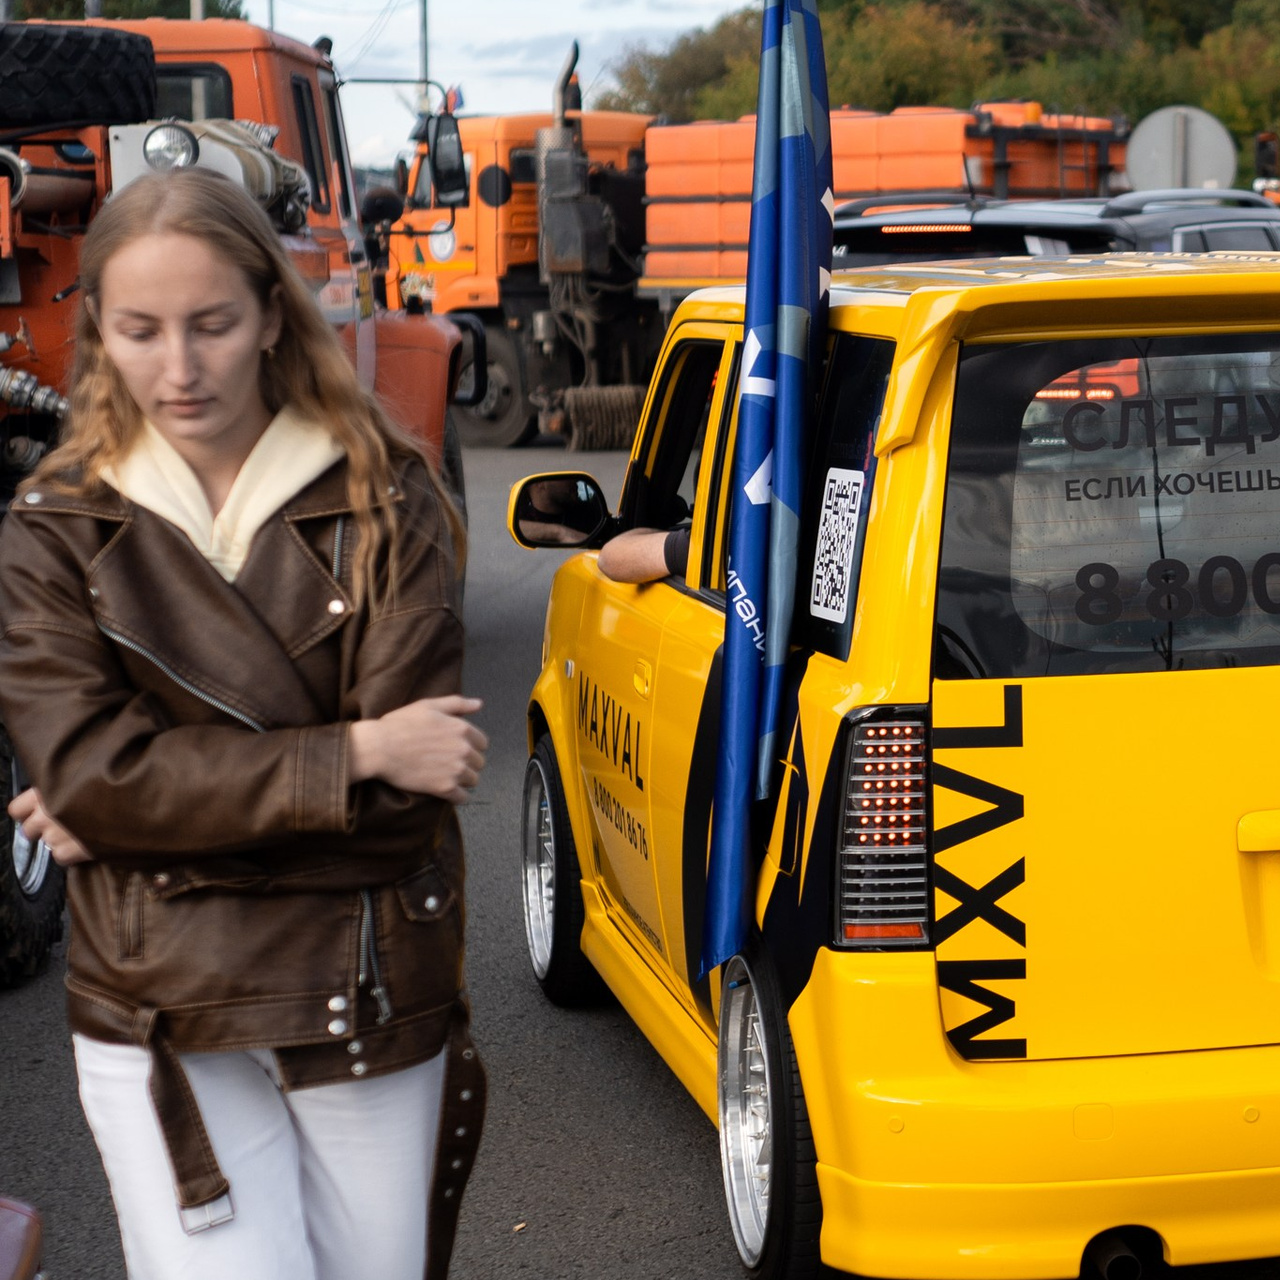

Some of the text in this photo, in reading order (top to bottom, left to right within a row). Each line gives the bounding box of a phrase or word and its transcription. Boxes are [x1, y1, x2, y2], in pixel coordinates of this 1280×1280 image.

[1064, 475, 1147, 502] ЕСЛИ
[1073, 562, 1124, 626] 8
[578, 670, 644, 793] MAXVAL
[599, 781, 613, 823] 800
[612, 796, 628, 839] 201
[626, 811, 638, 850] 86
[636, 821, 649, 861] 76
[932, 684, 1027, 1060] MXVL
